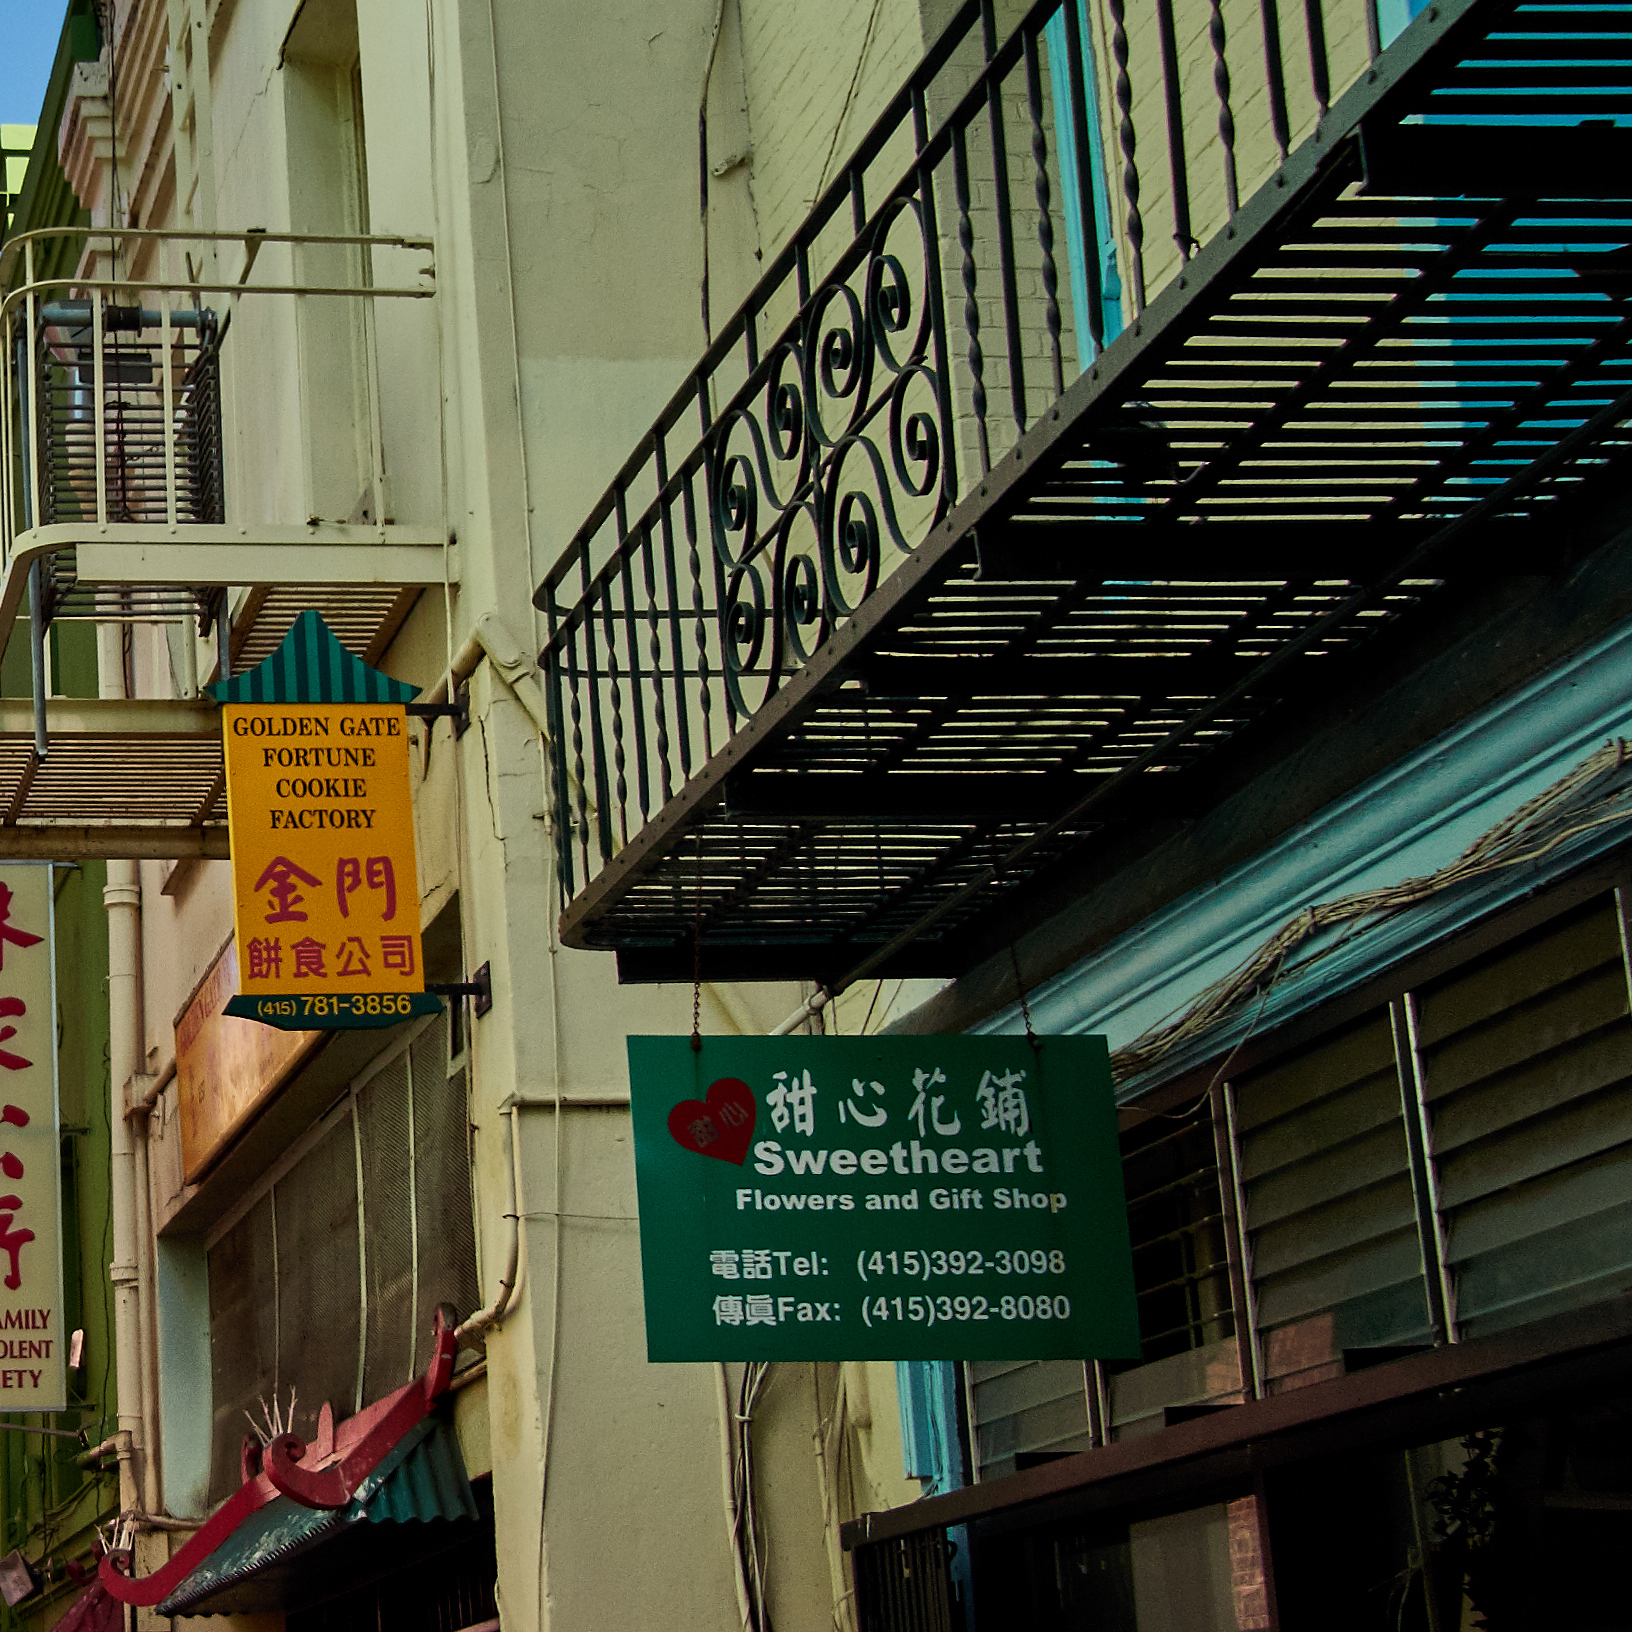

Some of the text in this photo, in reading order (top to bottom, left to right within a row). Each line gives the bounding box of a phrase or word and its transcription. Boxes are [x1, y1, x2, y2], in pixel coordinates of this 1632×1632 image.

[233, 715, 401, 738] GOLDEN GATE
[263, 746, 375, 768] FORTUNE
[276, 776, 367, 800] COOKIE
[269, 807, 375, 831] FACTORY
[254, 855, 397, 924] 金門
[257, 992, 412, 1018] (415) 781-3856
[766, 1066, 1032, 1138] 甜心花鋪
[754, 1140, 1043, 1176] Sweetheart
[736, 1188, 1067, 1214] Flowers and Gift Shop
[857, 1249, 1065, 1282] (415)392-3098
[862, 1295, 1070, 1328] (415)392-8080
